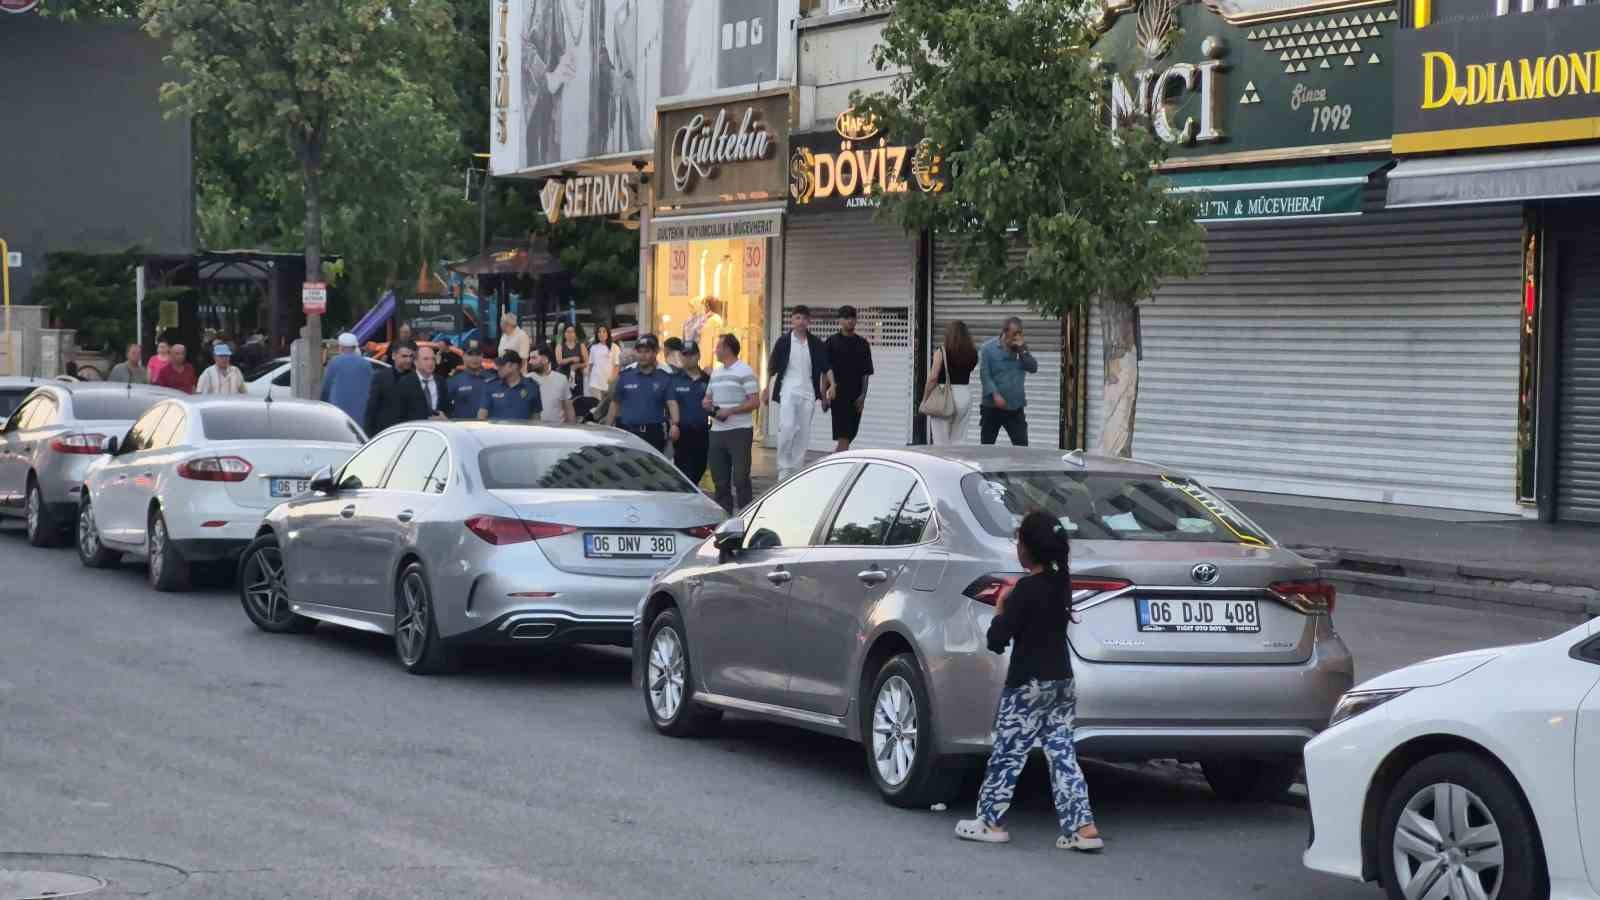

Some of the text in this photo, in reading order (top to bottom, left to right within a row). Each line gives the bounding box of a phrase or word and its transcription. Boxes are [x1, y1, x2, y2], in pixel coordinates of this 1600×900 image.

[1291, 83, 1327, 111] Since
[1310, 104, 1352, 133] 1992
[672, 107, 770, 191] Gültekin
[814, 138, 907, 198] DÖVİZ
[564, 175, 629, 218] SETRMS
[1247, 195, 1325, 215] MÜCEVHERAT
[746, 246, 761, 266] 30
[594, 536, 673, 552] 06 DNV 380
[1151, 602, 1255, 623] 06 DJD 408
